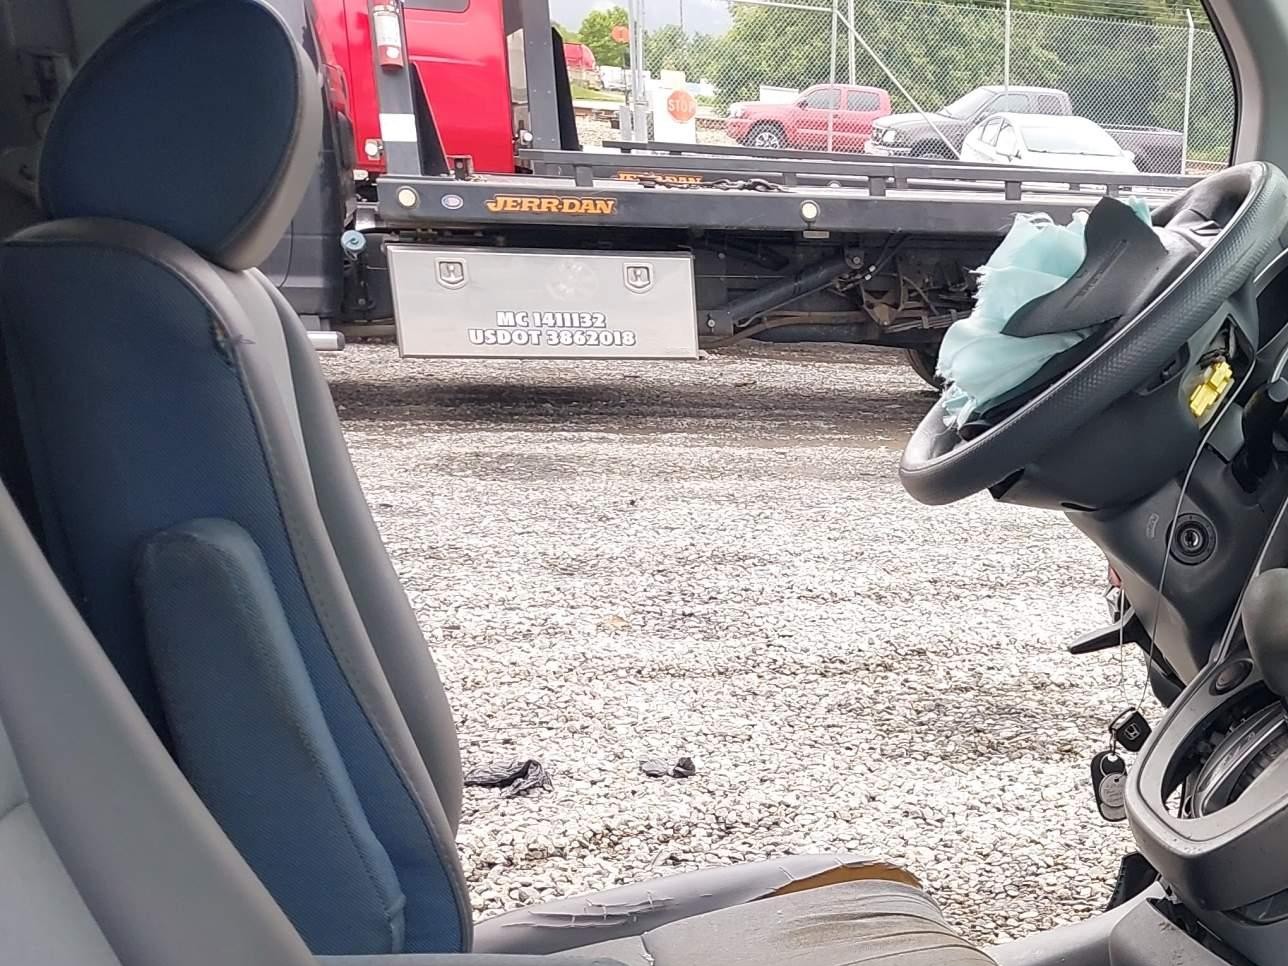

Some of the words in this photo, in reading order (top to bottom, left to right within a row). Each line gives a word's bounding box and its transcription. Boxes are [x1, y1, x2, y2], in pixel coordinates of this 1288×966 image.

[486, 195, 614, 214] JERR-DAN
[496, 311, 529, 327] MC
[532, 311, 607, 328] 1411132
[468, 328, 541, 345] USDOT
[546, 330, 636, 346] 3862018
